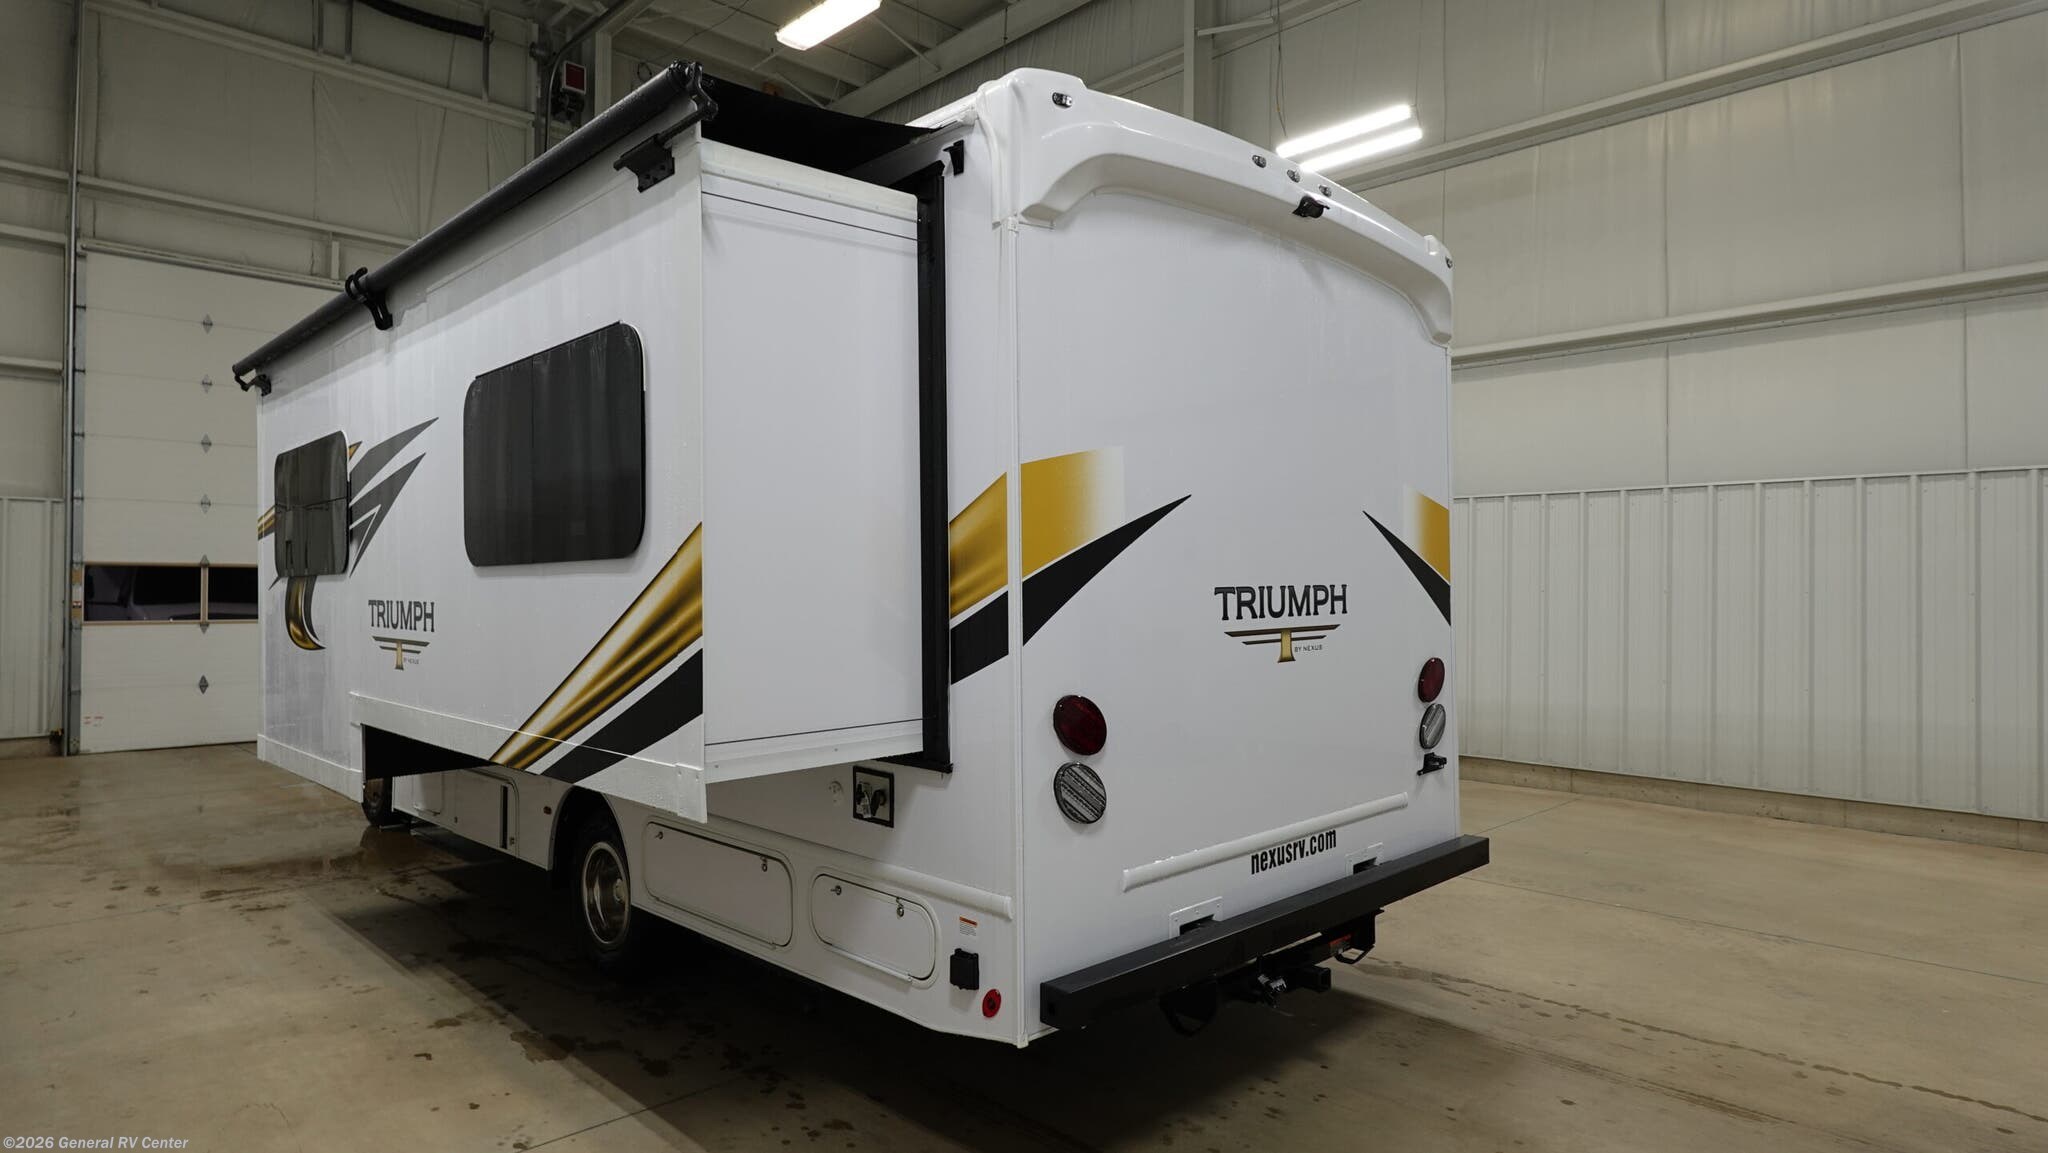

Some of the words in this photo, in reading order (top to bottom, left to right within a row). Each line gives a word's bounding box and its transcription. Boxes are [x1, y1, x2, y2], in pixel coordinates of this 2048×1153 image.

[368, 600, 435, 632] TRIUMPH
[1214, 584, 1348, 621] TRIUMPH
[1302, 644, 1323, 652] NEXUS
[1251, 829, 1337, 875] nexusrv.com
